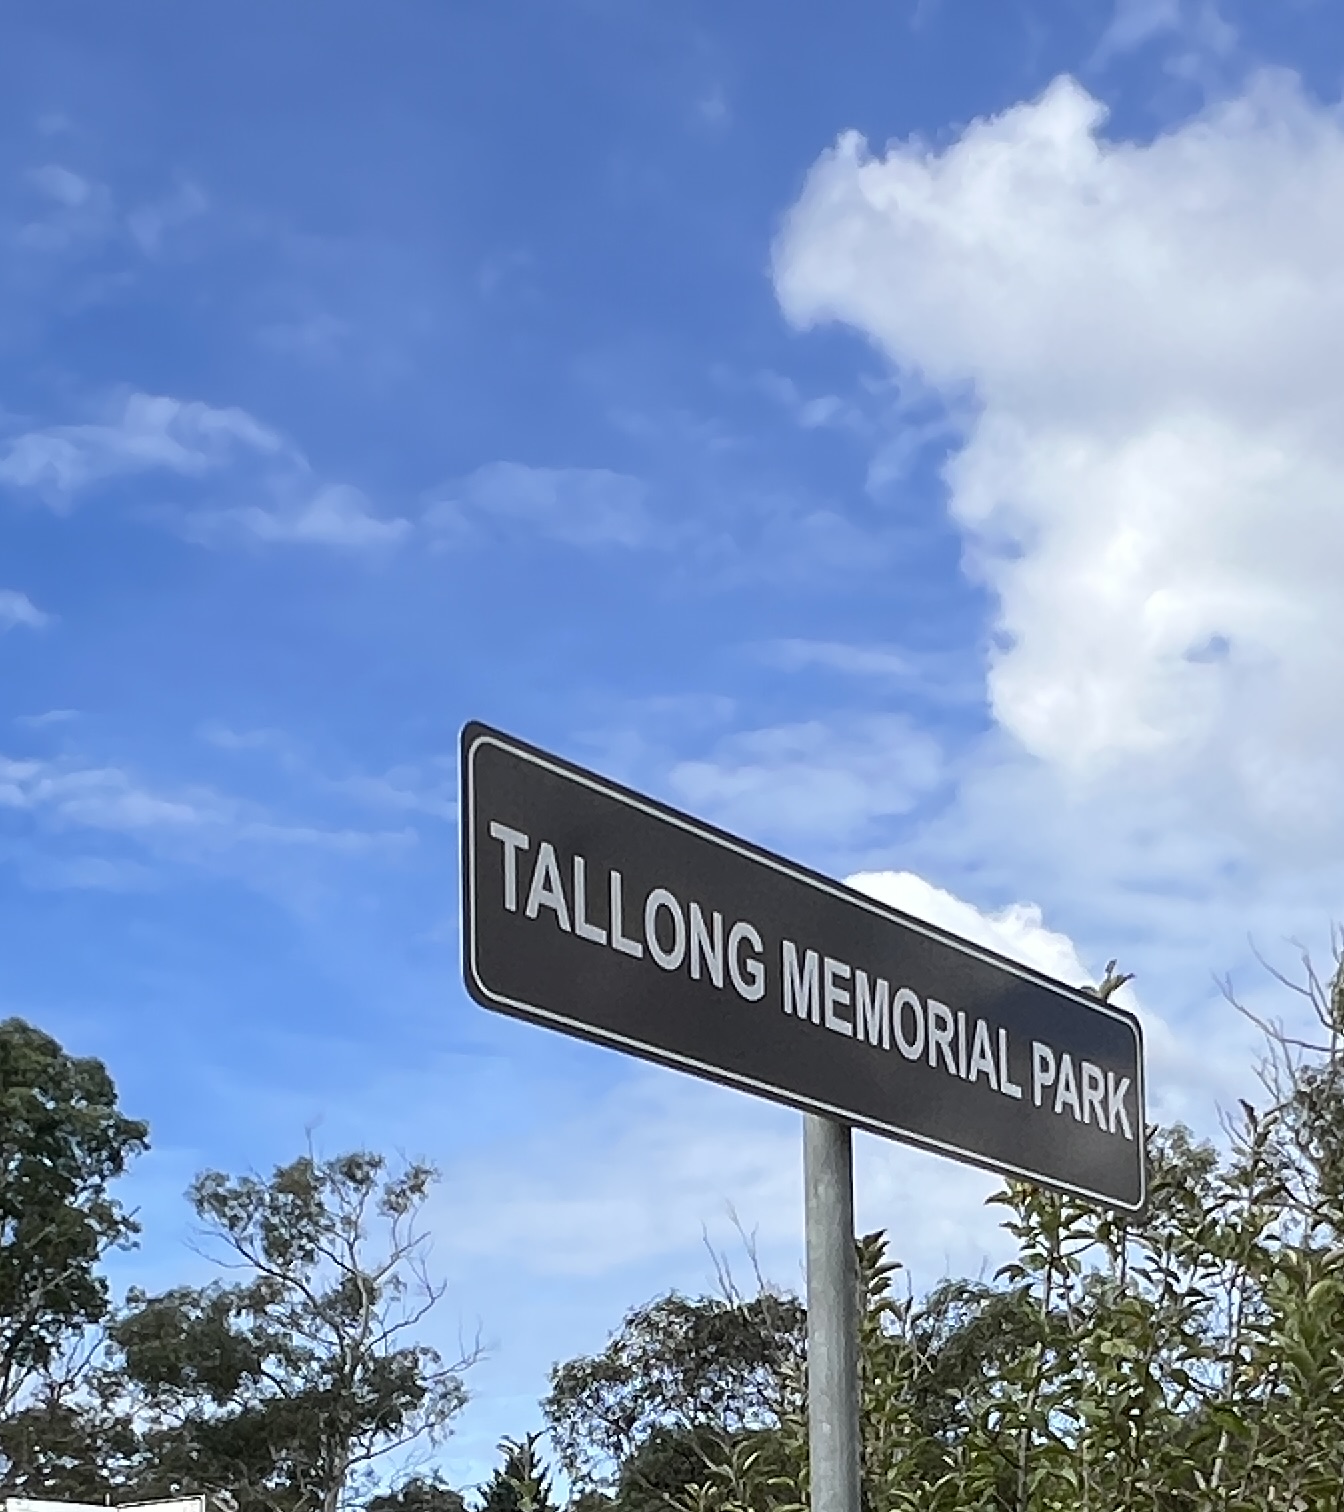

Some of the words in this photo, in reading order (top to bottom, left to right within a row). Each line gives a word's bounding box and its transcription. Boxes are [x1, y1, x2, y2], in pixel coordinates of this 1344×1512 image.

[490, 820, 765, 1002] TALLONG
[782, 940, 1023, 1100] MEMORIAL
[1032, 1040, 1134, 1142] PARK
